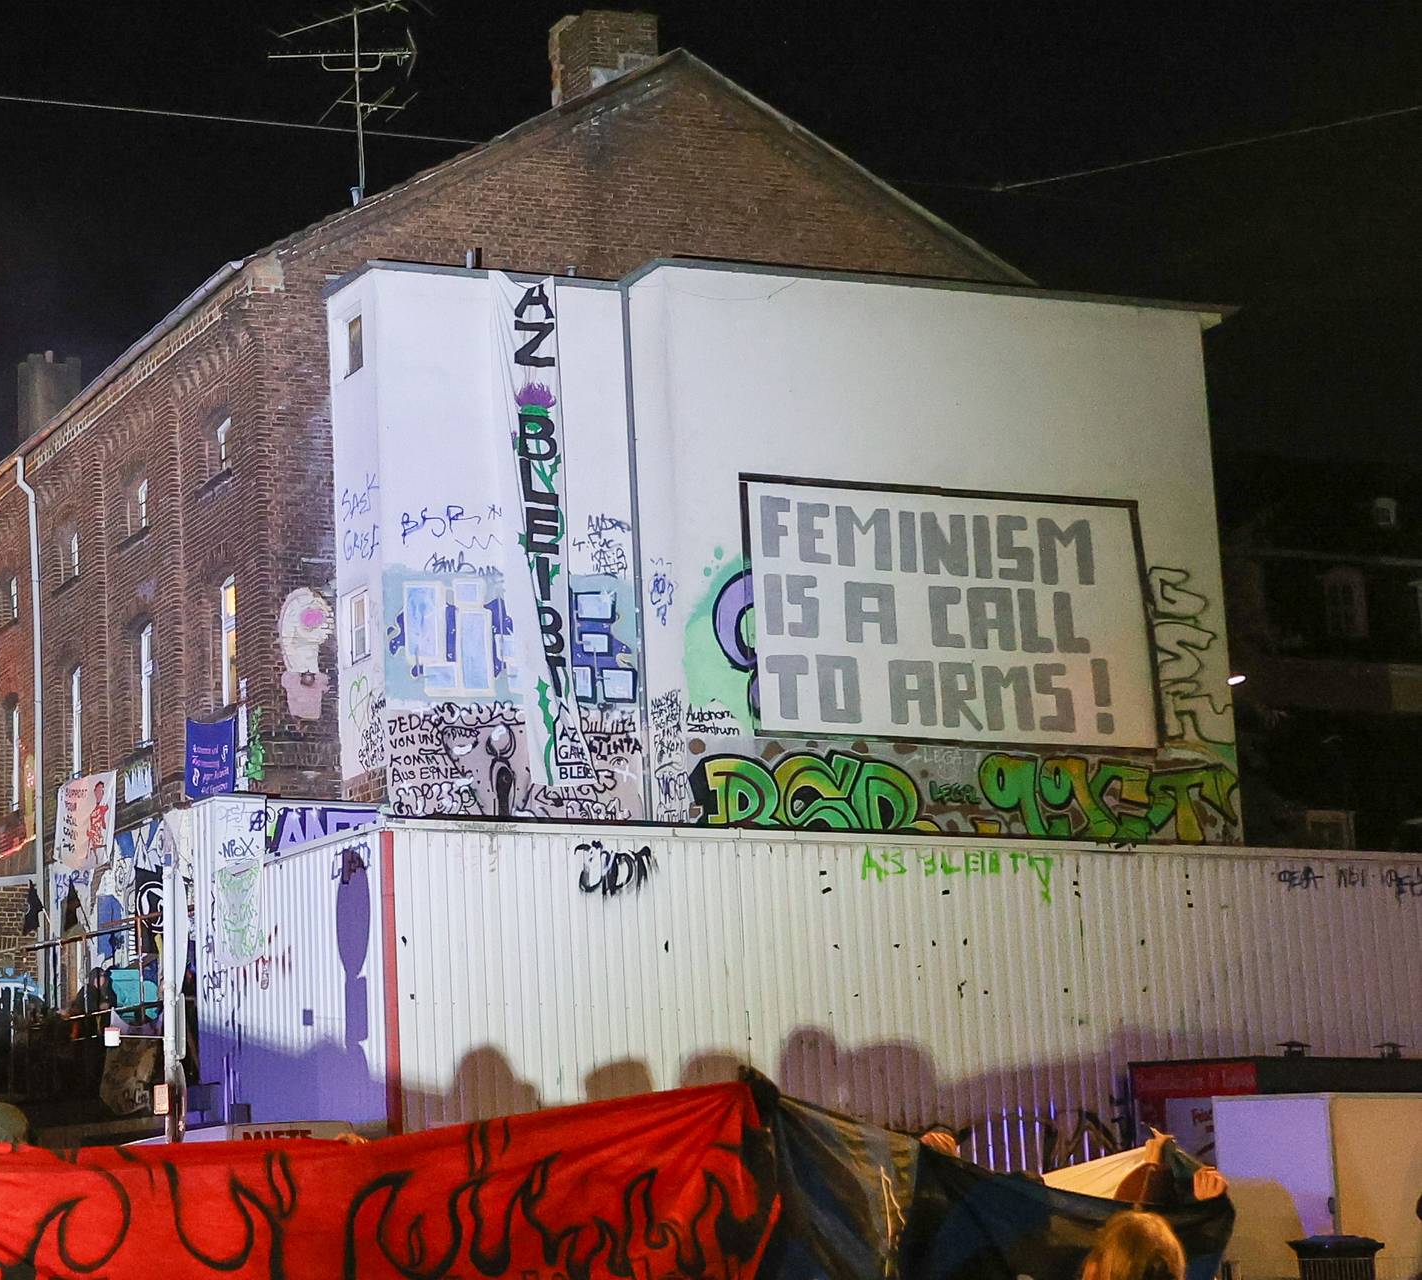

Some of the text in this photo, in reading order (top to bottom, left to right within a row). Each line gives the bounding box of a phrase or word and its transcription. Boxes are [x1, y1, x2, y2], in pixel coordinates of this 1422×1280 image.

[760, 495, 1095, 585] FEMINISM
[764, 574, 1091, 654] IS A CALL
[766, 654, 862, 725] TO
[390, 734, 415, 749] VON
